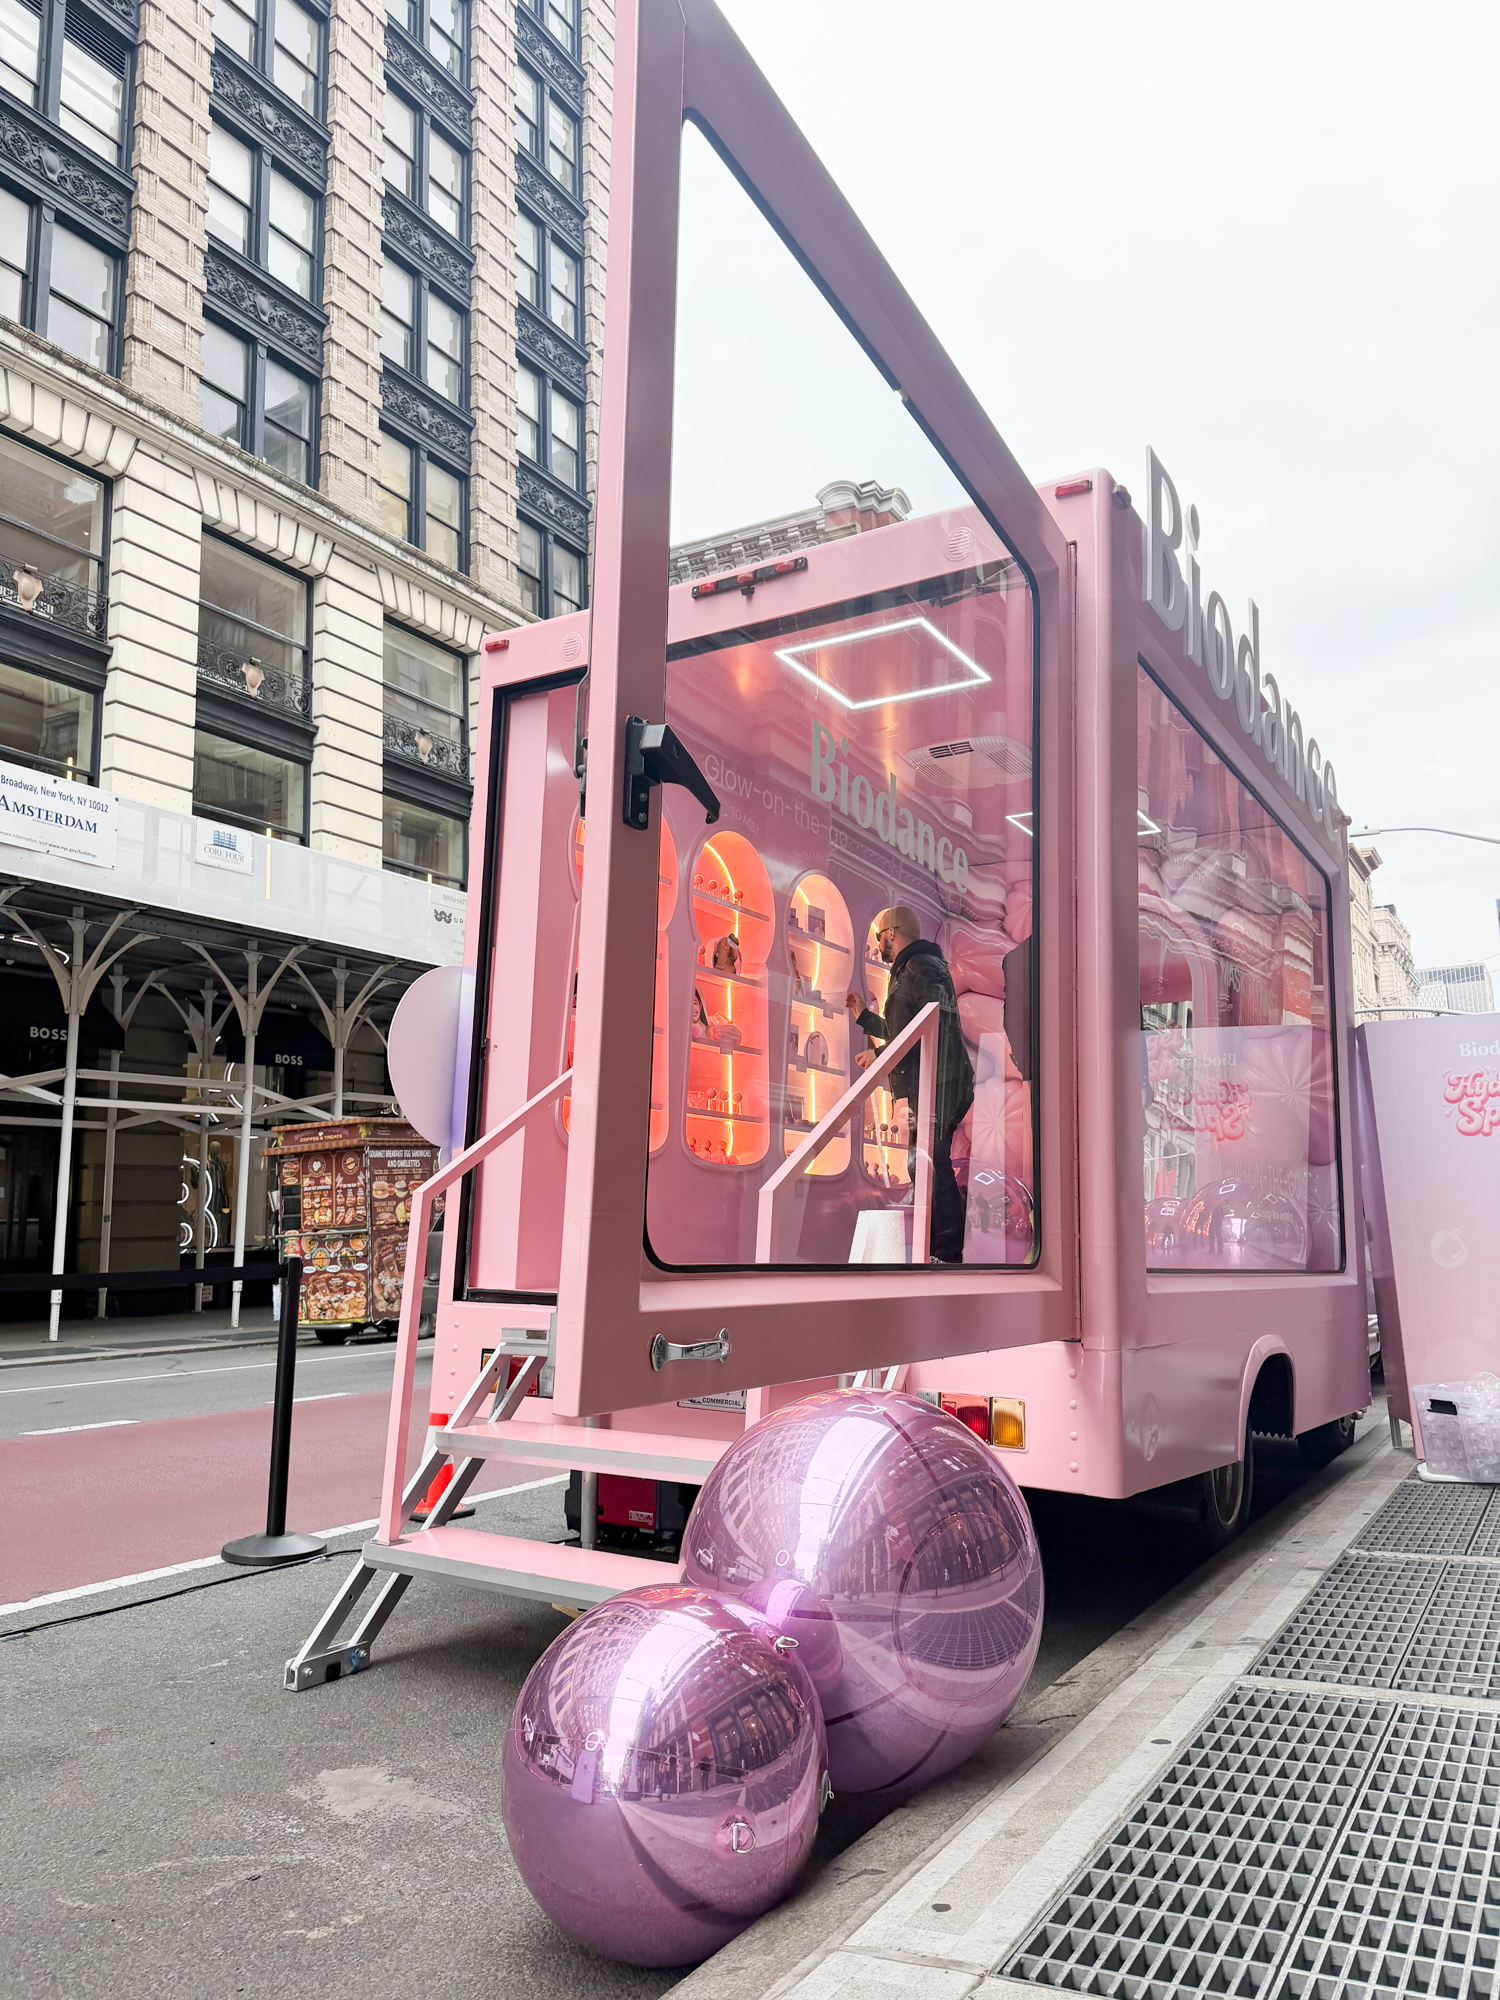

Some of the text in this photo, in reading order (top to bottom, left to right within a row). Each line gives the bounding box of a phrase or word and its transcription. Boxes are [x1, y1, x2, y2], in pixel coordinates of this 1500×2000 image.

[1146, 444, 1338, 841] Biodance
[0, 775, 109, 813] Broadway, New York, NY 10012
[811, 720, 969, 893] Biodance
[0, 794, 98, 834] AMSTERDAM
[731, 807, 760, 836] TO MIST
[204, 846, 245, 862] CORE FOUR
[30, 1026, 67, 1041] BOSS
[275, 1054, 303, 1066] BOSS
[702, 1397, 741, 1407] COMMERCIAL
